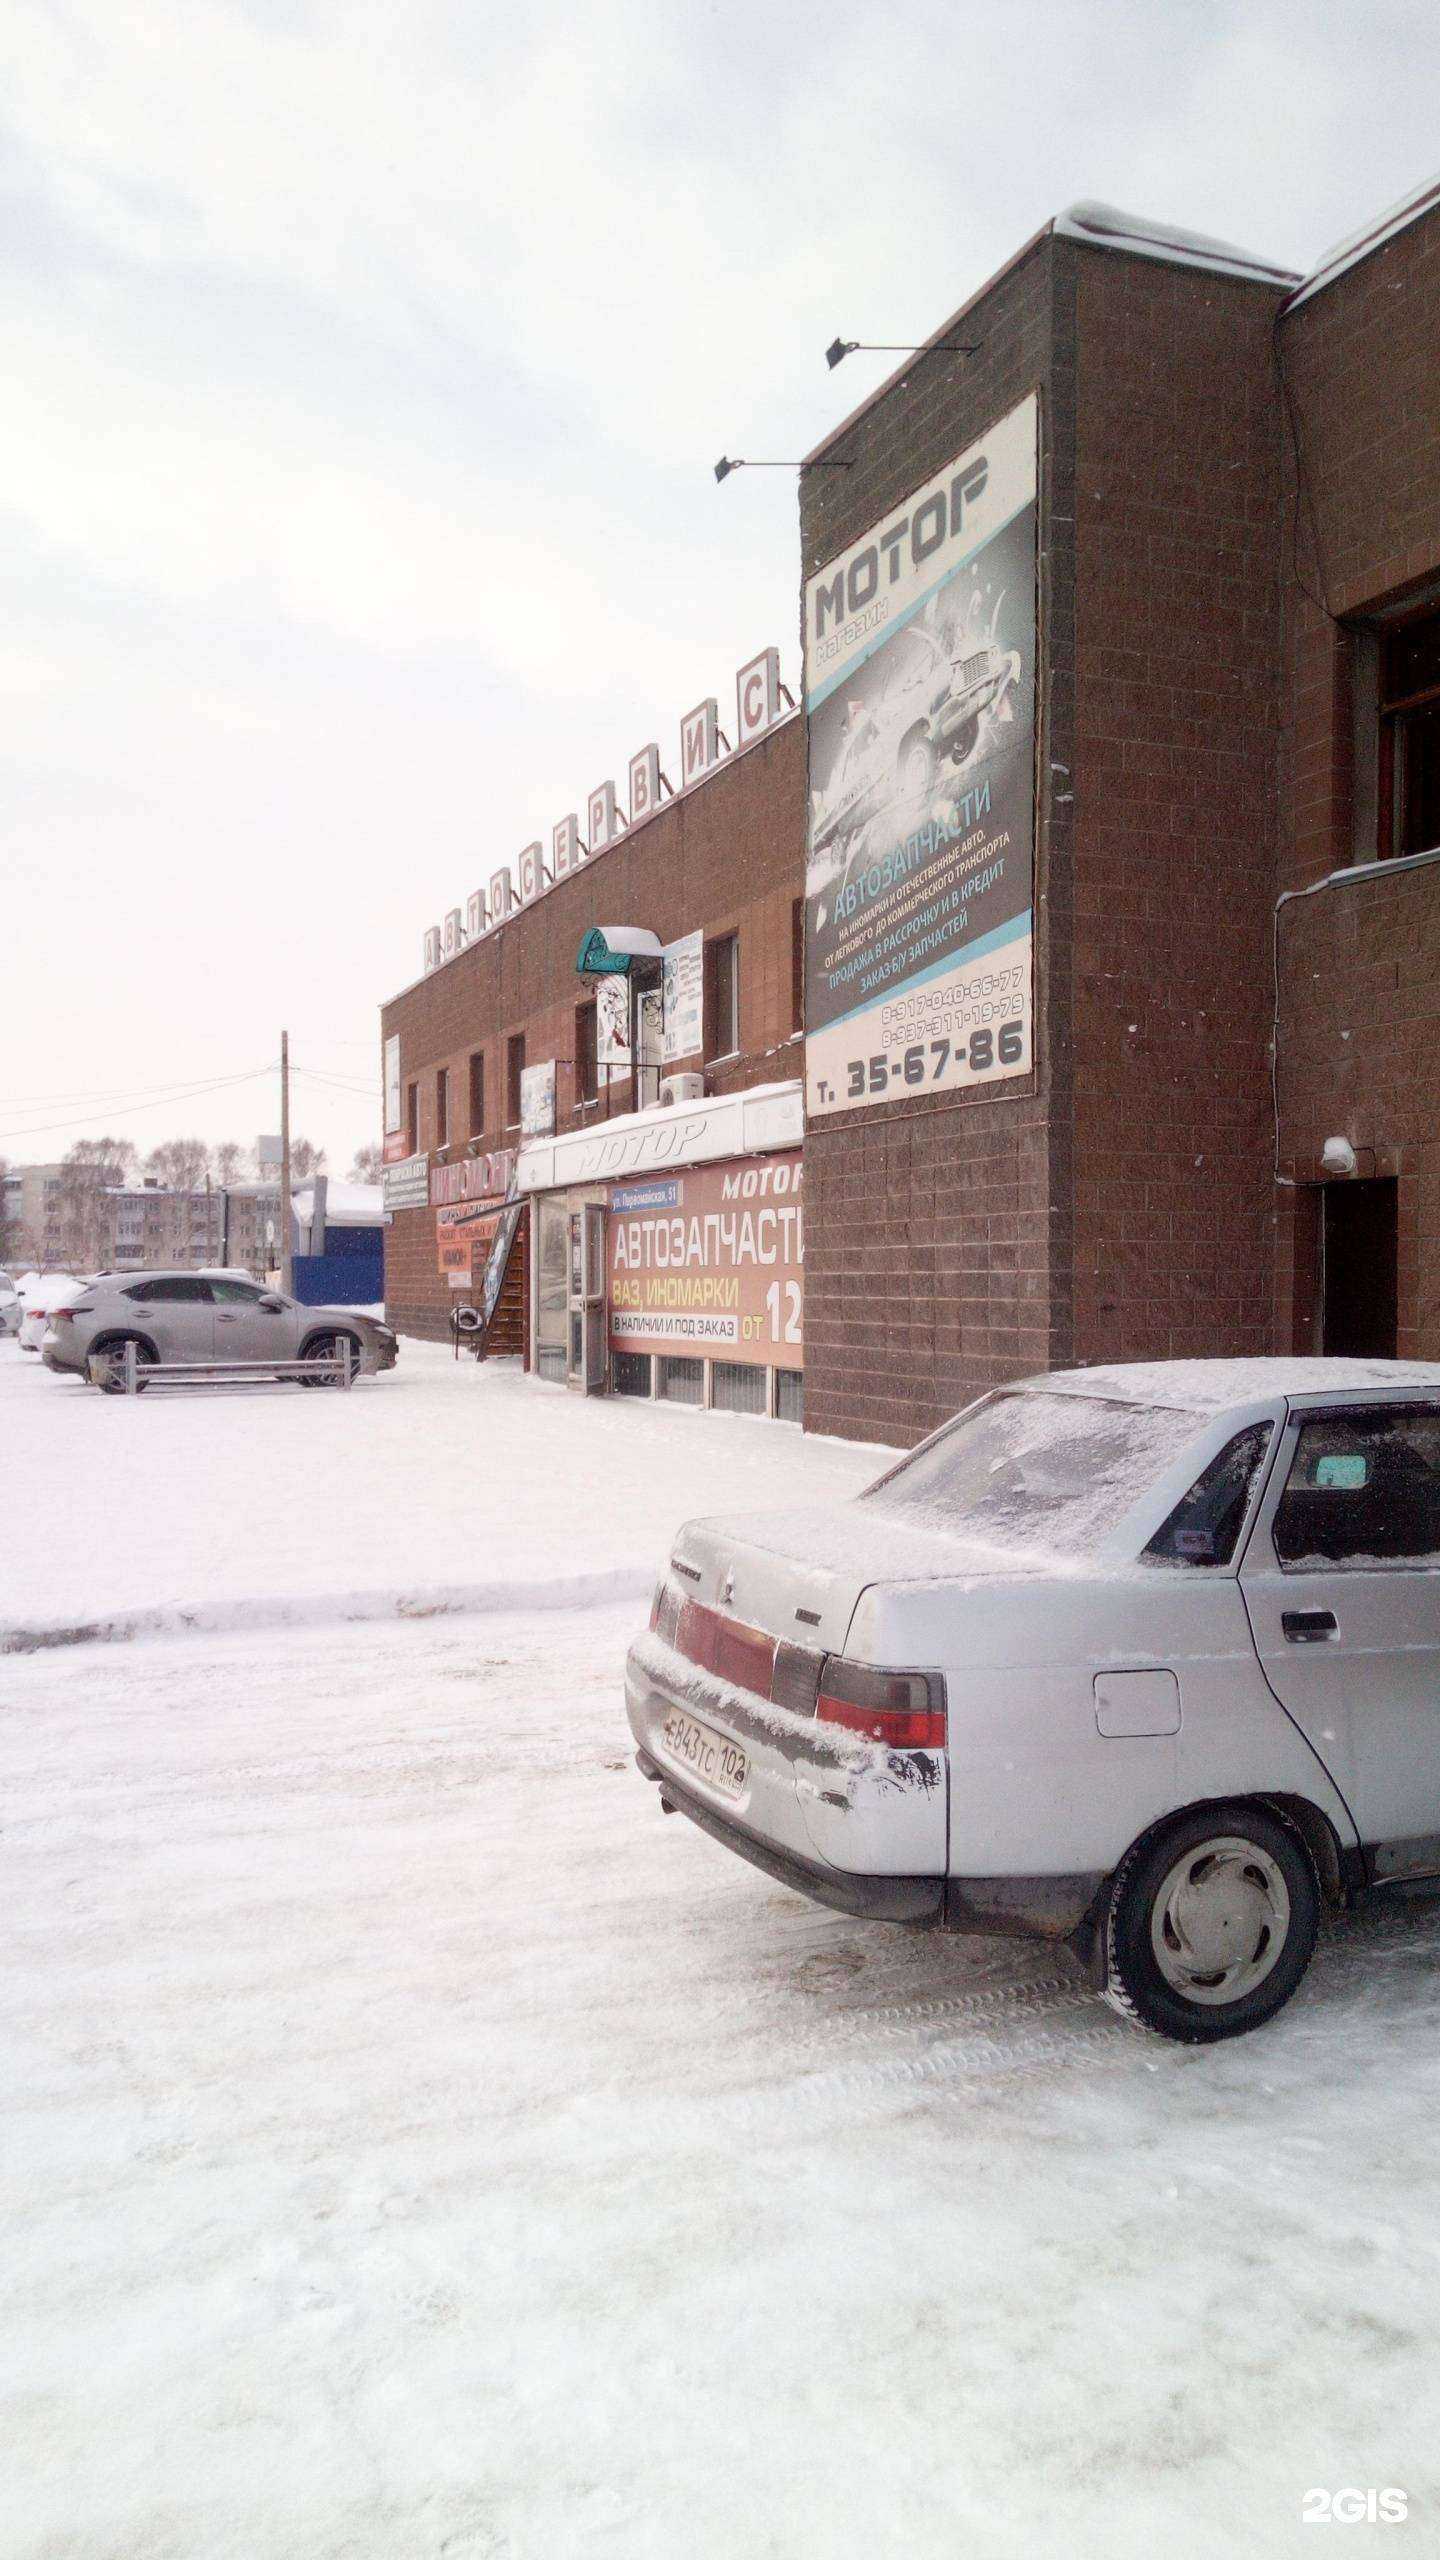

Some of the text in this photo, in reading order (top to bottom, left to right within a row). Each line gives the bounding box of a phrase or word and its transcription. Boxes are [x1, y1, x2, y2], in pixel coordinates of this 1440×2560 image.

[816, 455, 988, 640] МОТОР
[425, 672, 764, 966] АВТОСЕРВИС
[833, 779, 992, 925] АВТОЗАПЧАСТИ
[824, 831, 1010, 969] ОТ ЛЕГКОВОГО ДО КОММЕРЧЕСКОГО ТРАНСПОРТА
[828, 858, 1005, 990] ПРОДАЖА В РАССРОЧКУ И В КРЕДИТ
[838, 927, 849, 942] НА
[849, 897, 889, 935] ИНОМАРКИ
[897, 846, 960, 900] ОТЕЧЕСТВЕННЫЕ
[908, 906, 968, 962] ЗАПЧАСТЕЙ
[881, 993, 1024, 1048] 8-937-311-19-79
[847, 1020, 1023, 1098] 35-67-86
[578, 1119, 707, 1174] МОТОР
[668, 1185, 676, 1201] 51
[612, 1277, 739, 1312] ВАЗ, ИНОМАРКИ
[614, 1316, 735, 1337] В НАЛИЧИИ И ПОД ЗАКАЗ
[721, 1745, 746, 1782] 102
